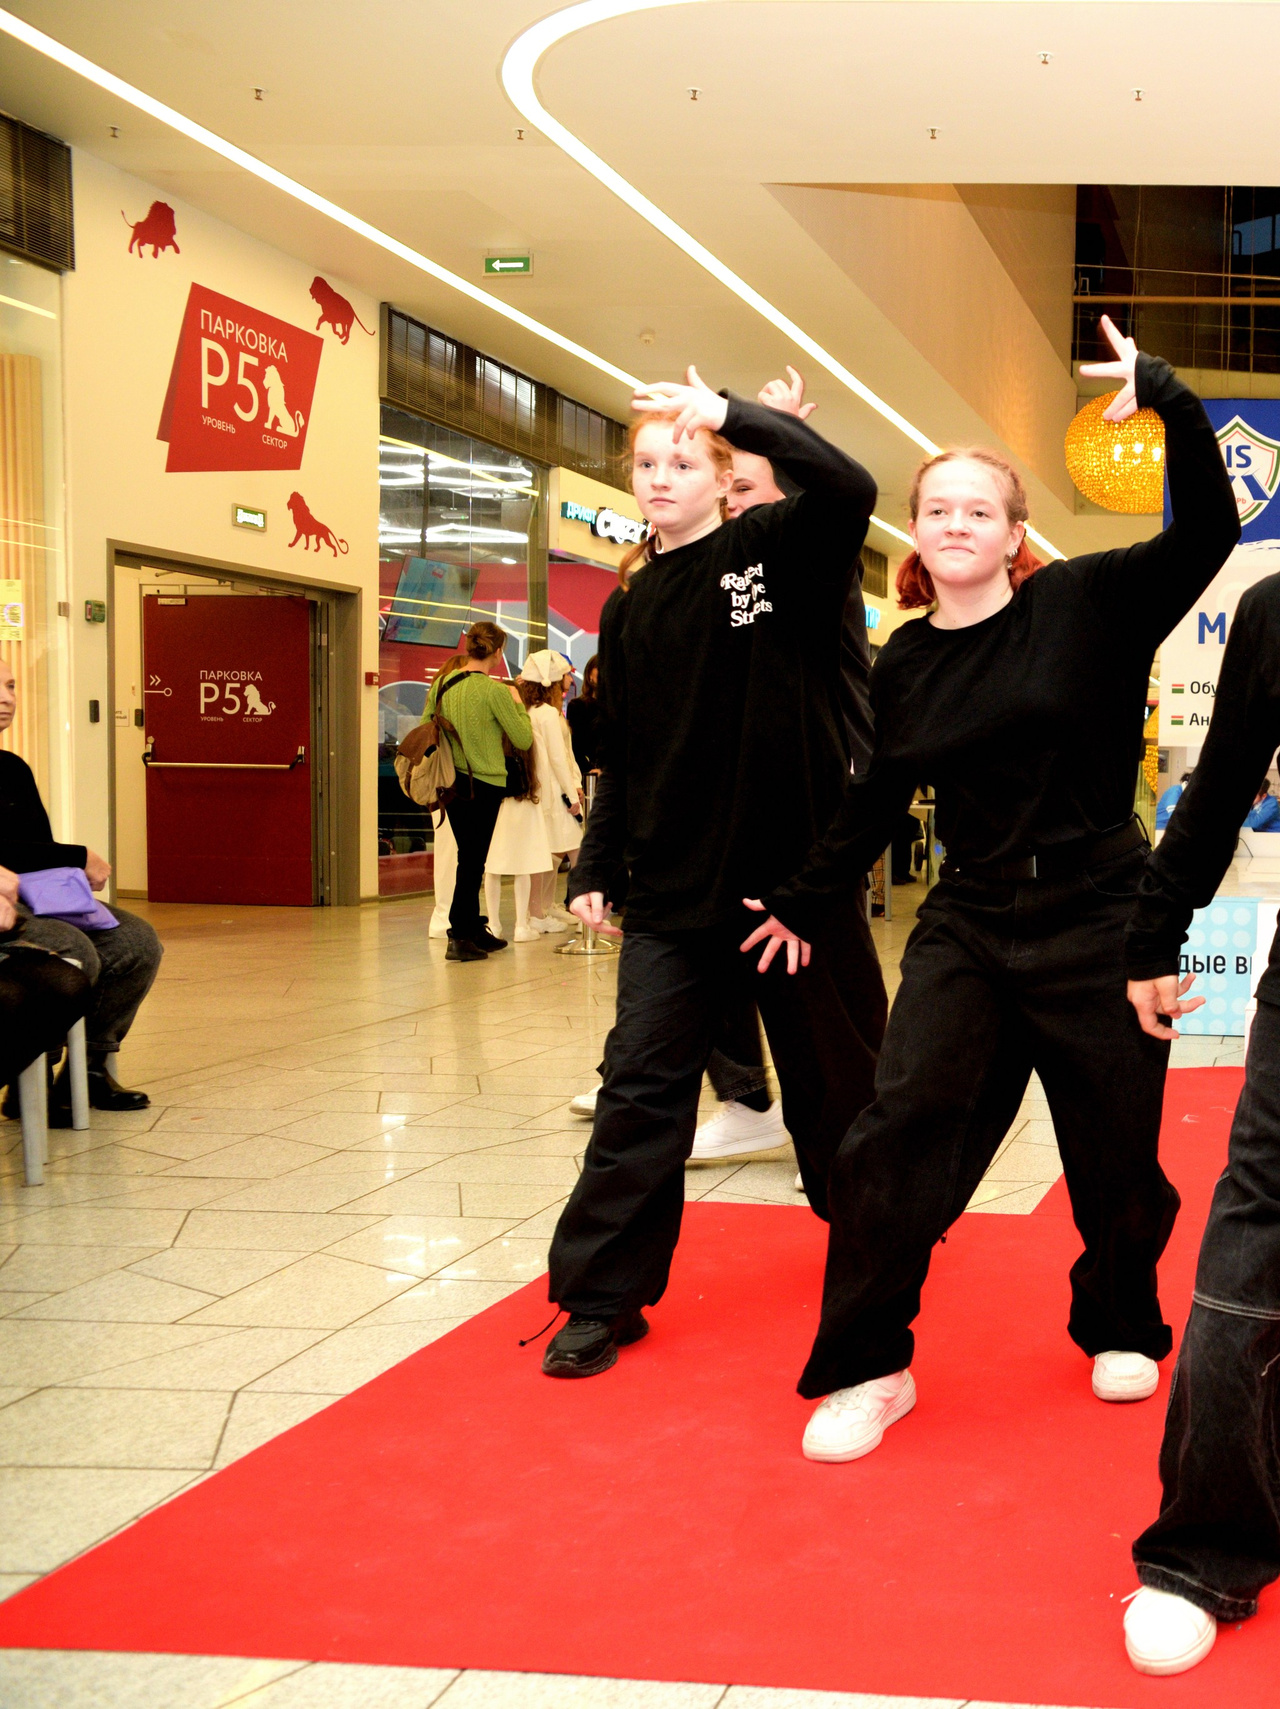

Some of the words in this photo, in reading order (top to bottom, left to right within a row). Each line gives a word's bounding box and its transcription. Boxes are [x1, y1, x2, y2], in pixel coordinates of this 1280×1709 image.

[201, 309, 288, 363] ПАРКОВКА
[201, 337, 259, 422] P5
[202, 415, 236, 434] УРОВЕНЬ
[262, 434, 287, 449] СЕКТОР
[731, 591, 751, 609] by
[200, 670, 263, 681] ПАРКОВКА
[200, 682, 241, 715] P5
